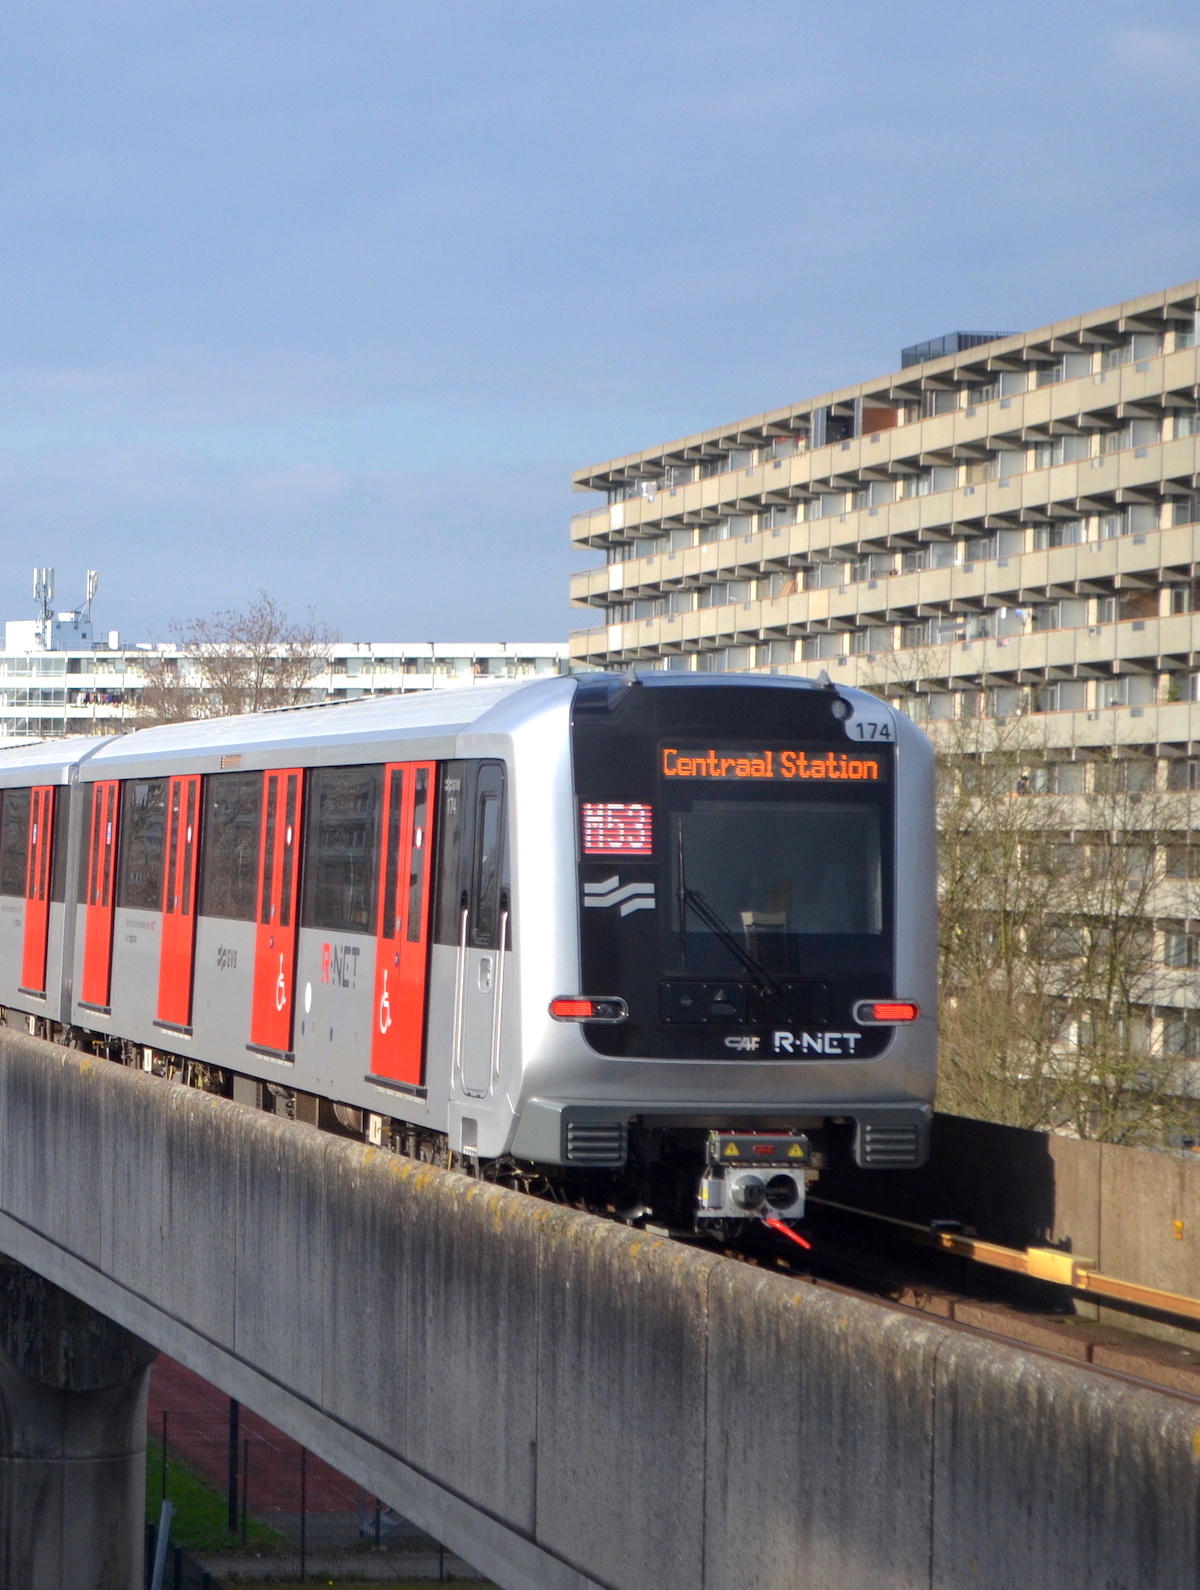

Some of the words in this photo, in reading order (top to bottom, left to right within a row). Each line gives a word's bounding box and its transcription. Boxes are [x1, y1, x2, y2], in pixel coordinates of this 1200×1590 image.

[856, 722, 891, 740] 174
[663, 748, 774, 778] Centraal
[780, 751, 879, 780] Station
[447, 797, 456, 814] 174
[586, 803, 646, 849] M53
[227, 949, 238, 969] GVB
[724, 1036, 761, 1051] CAF
